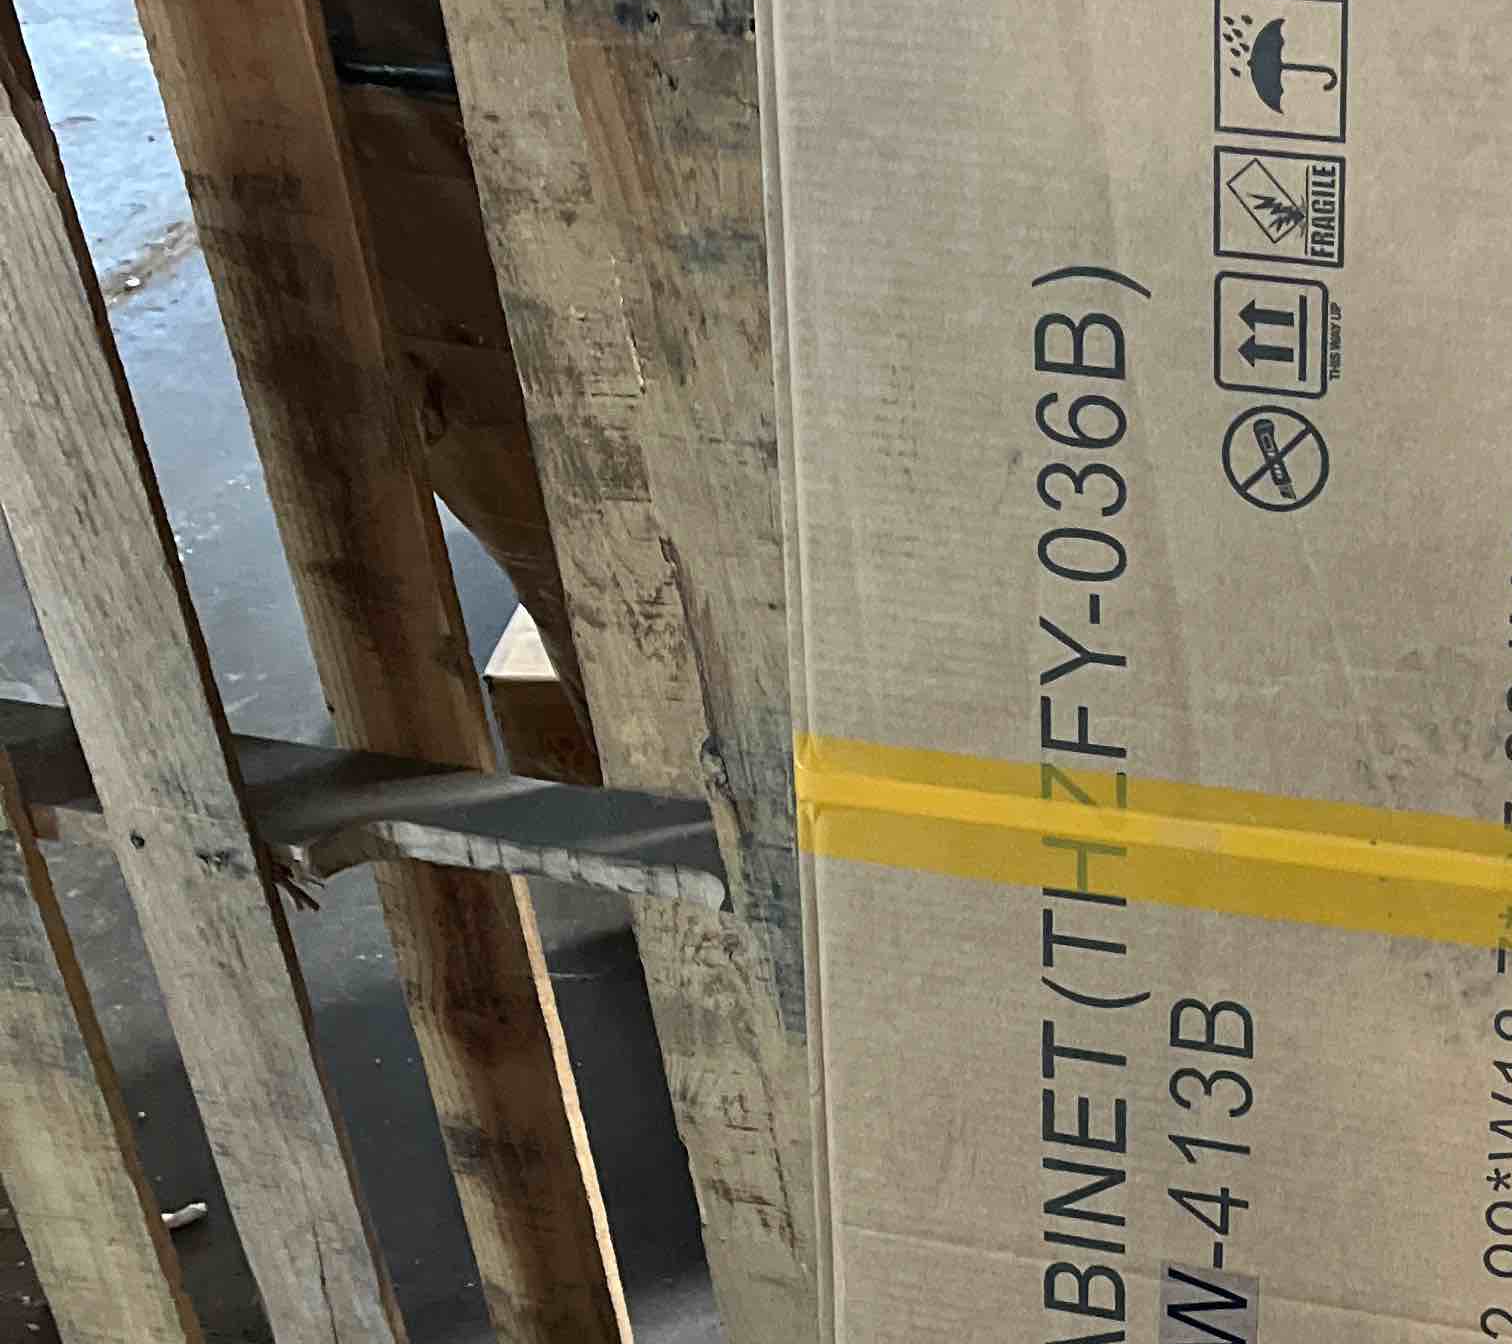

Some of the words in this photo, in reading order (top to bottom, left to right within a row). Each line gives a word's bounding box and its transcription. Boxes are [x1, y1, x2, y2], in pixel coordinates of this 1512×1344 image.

[1310, 164, 1336, 260] FRAGILE
[1329, 303, 1343, 321] UP
[1328, 322, 1342, 351] WAY
[1328, 352, 1342, 381] THIS
